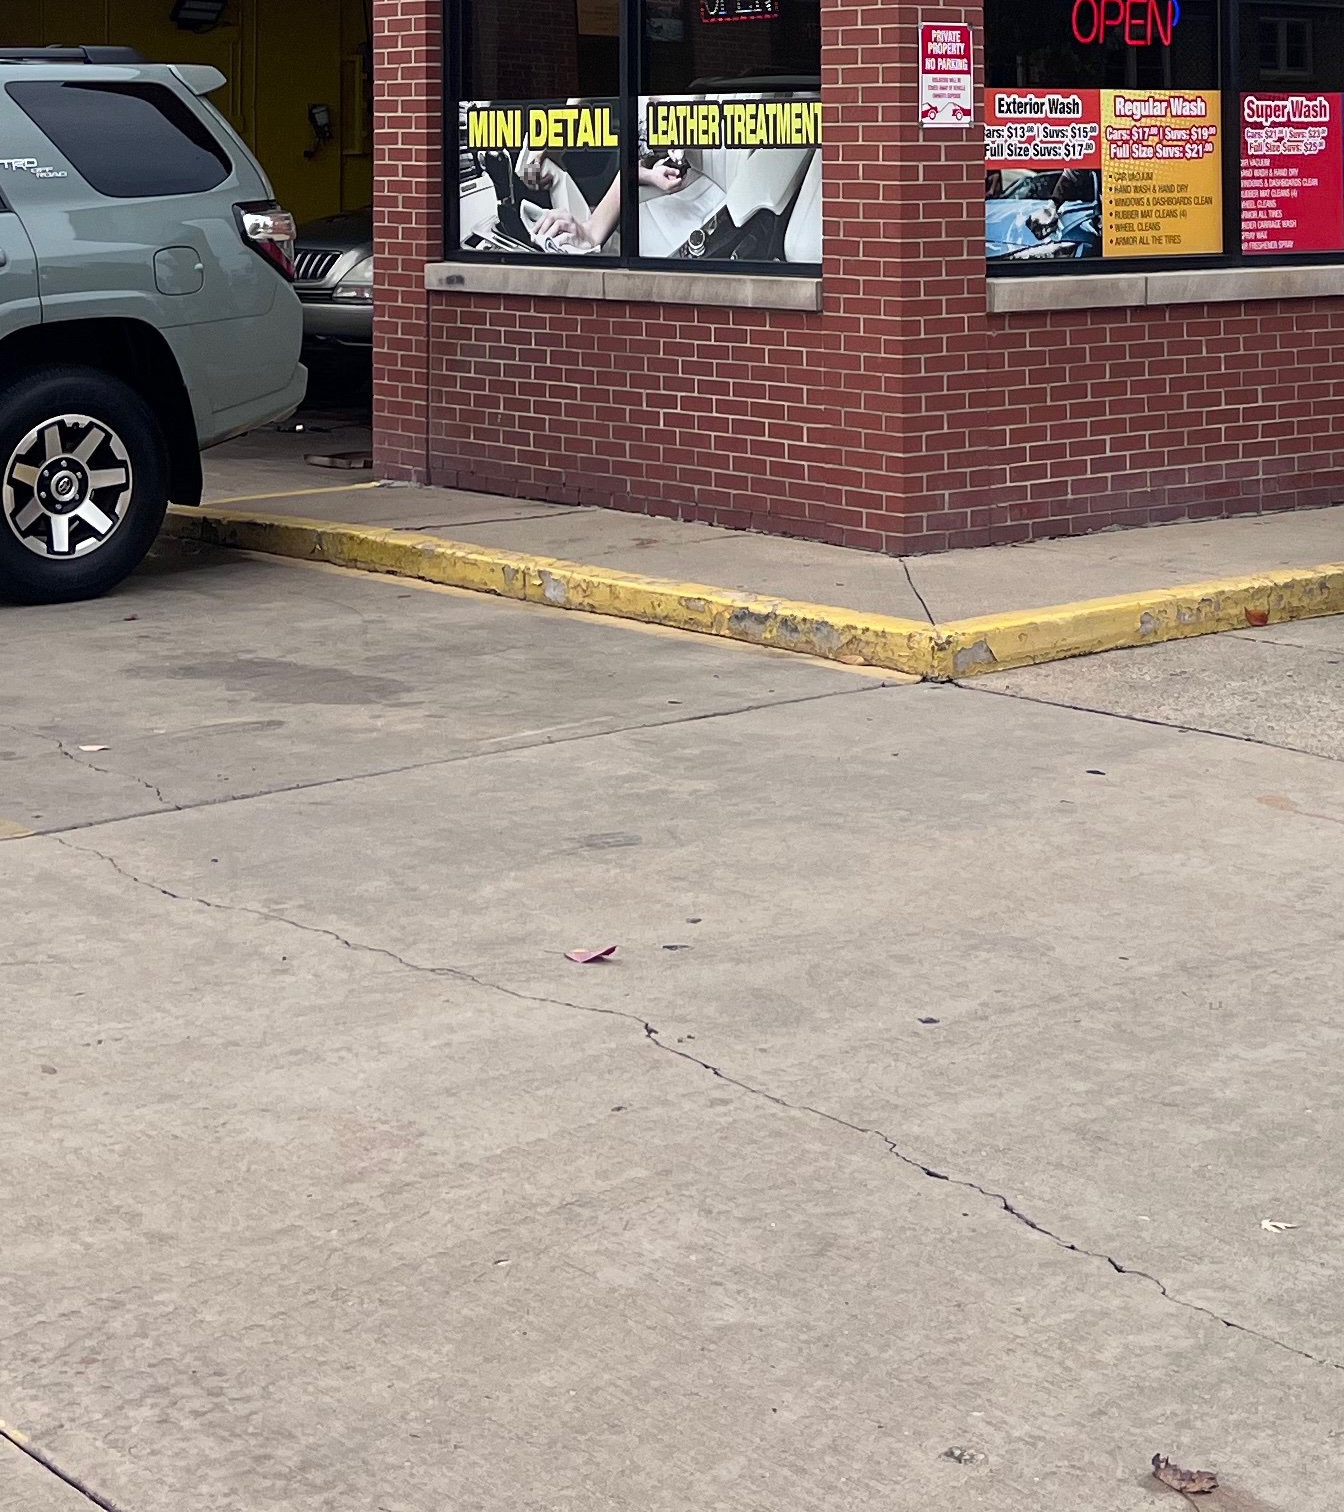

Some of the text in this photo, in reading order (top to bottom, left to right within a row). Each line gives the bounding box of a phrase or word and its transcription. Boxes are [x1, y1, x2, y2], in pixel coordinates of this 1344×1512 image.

[931, 29, 961, 43] PRIVATE
[928, 42, 965, 55] PROPERTY
[925, 58, 968, 71] NO PARKING
[997, 97, 1080, 115] Exterior Wash
[1115, 97, 1206, 119] Regular Wash
[1246, 99, 1327, 122] Super Wash
[468, 107, 618, 148] MINI DETAIL
[648, 102, 822, 145] LEATHER TREATMENT
[985, 127, 1004, 139] ars:
[1042, 126, 1068, 139] Suvs:
[1106, 127, 1130, 140] Cars:
[1165, 127, 1190, 140] Suvs:
[985, 143, 1003, 157] Full
[1007, 143, 1030, 157] Size
[1033, 143, 1062, 157] Suvs:
[1110, 143, 1130, 158] Full
[1132, 143, 1154, 158] Size
[1156, 143, 1184, 158] Suvs:
